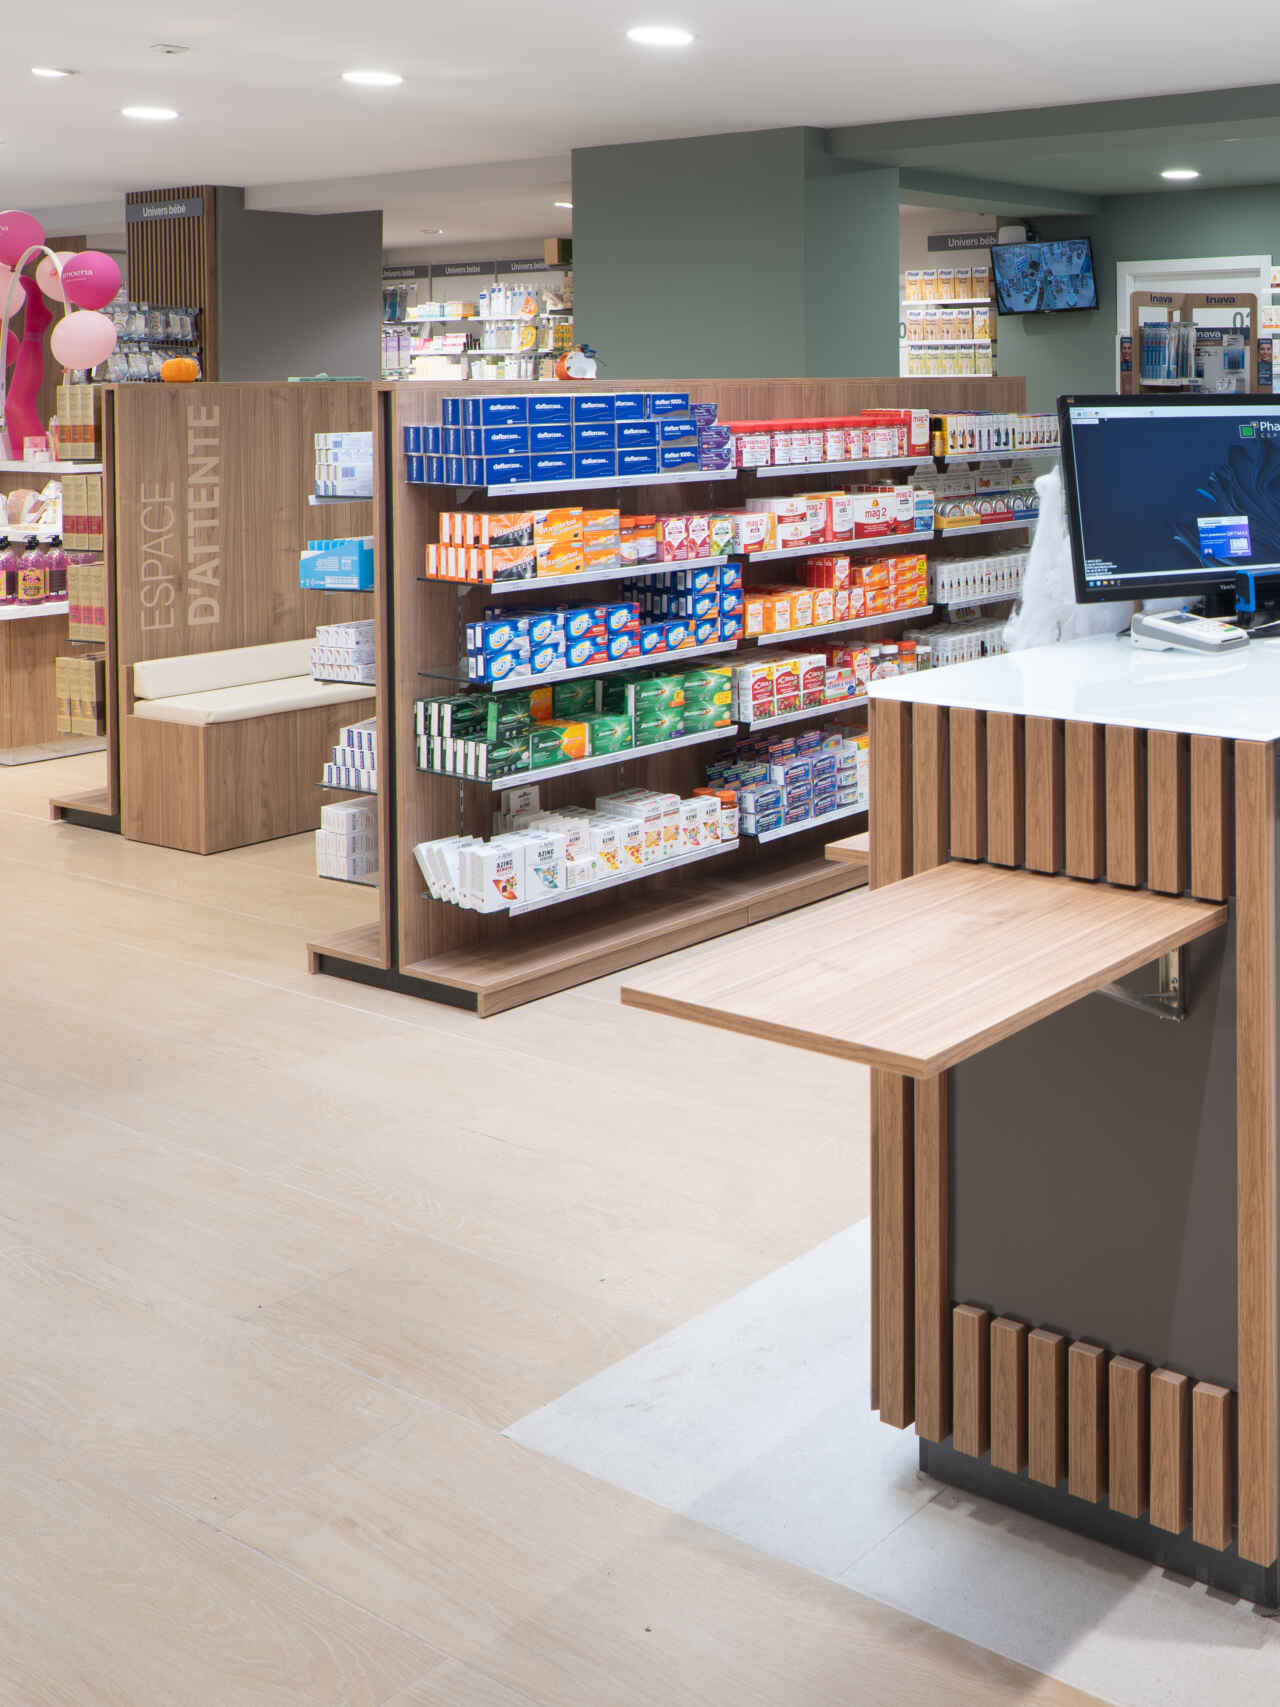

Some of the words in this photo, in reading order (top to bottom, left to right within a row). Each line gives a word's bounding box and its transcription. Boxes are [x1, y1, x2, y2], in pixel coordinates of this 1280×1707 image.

[948, 238, 979, 248] Univers
[980, 236, 996, 246] béb
[187, 405, 220, 626] D'ATTENTE
[865, 510, 881, 520] mag
[881, 507, 887, 517] 2
[141, 481, 175, 630] ESPACE
